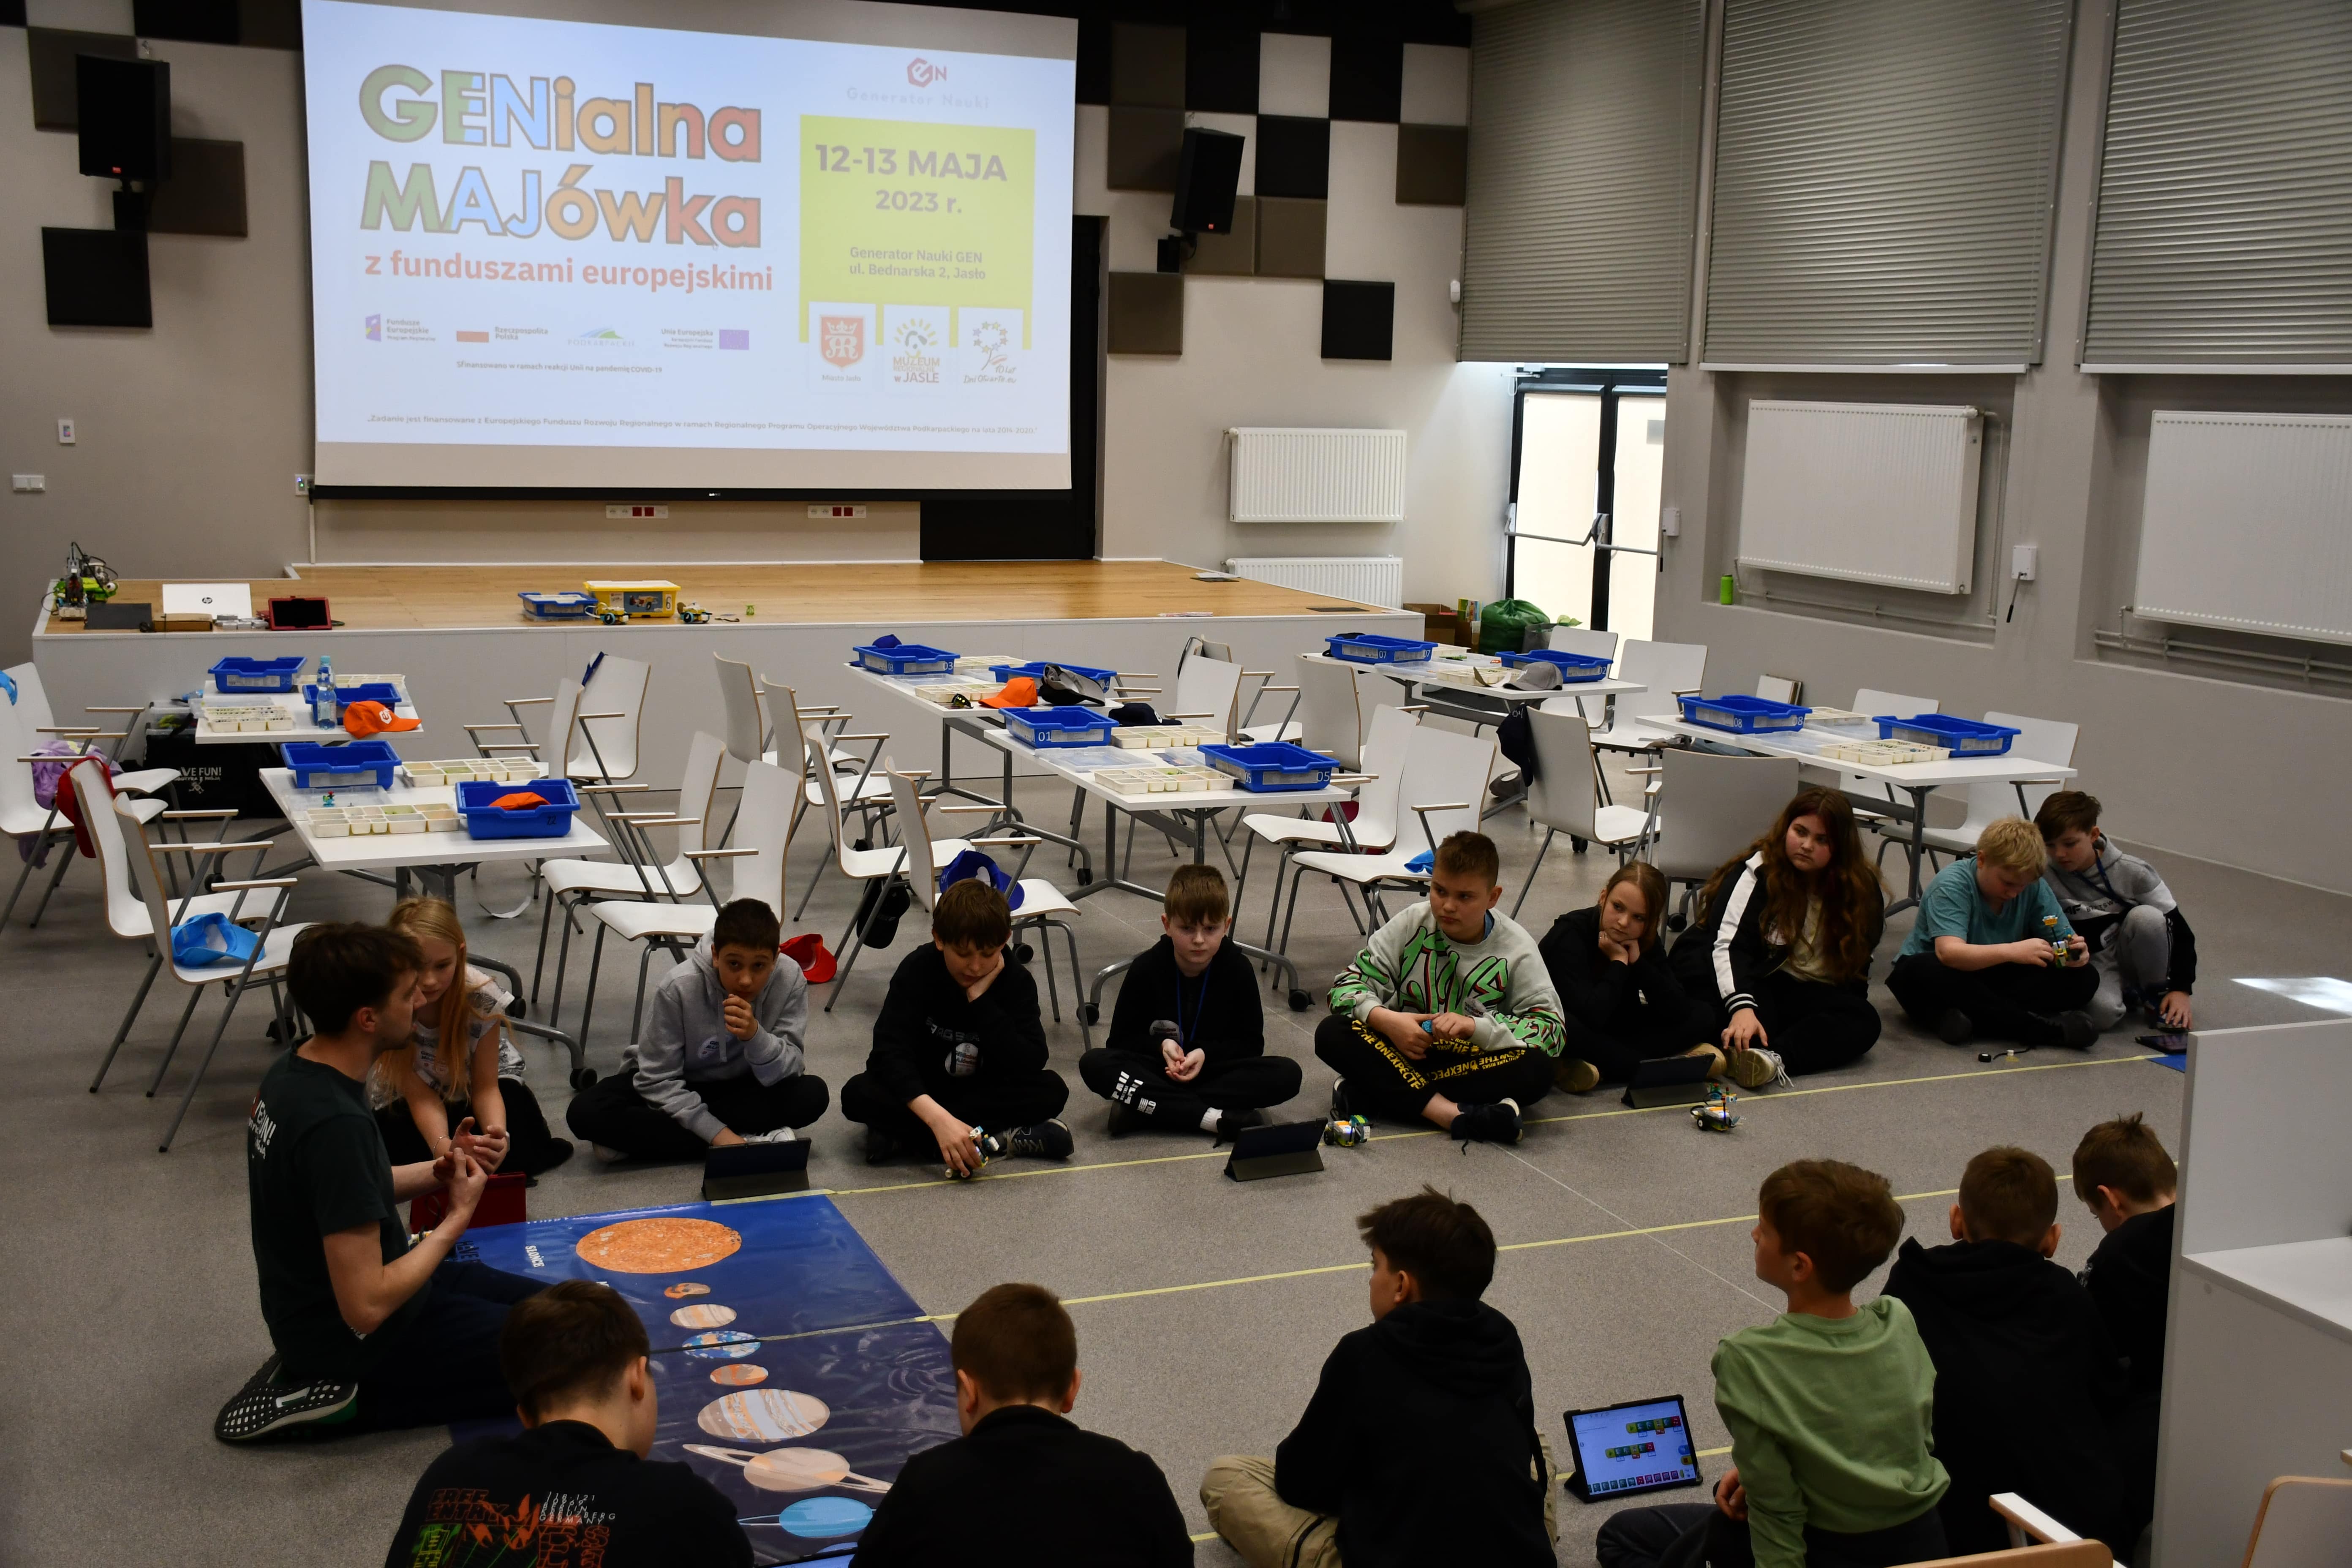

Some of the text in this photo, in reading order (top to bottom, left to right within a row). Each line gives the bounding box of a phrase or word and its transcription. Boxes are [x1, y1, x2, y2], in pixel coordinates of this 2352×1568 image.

[847, 87, 989, 109] Generator Nauki
[359, 64, 761, 163] GENialna
[815, 144, 1007, 182] 12-13 MAJA
[360, 160, 761, 248] MAJówka
[875, 190, 962, 213] 2023 r.
[850, 247, 983, 263] Generator Nauki GEN
[365, 251, 773, 293] z funduszami europejskimi
[849, 264, 986, 280] ul. Bednarska 2, Jasło
[495, 327, 548, 335] Rzeczpospolita
[456, 360, 507, 369] Sfinansowano
[545, 364, 568, 372] reakcji
[893, 357, 940, 367] MUZEUM
[406, 415, 421, 423] jest
[485, 417, 541, 425] Europejskiego
[584, 419, 617, 427] Rozwoju
[620, 419, 672, 428] Regionalnego
[807, 423, 858, 431] Operacyjnego
[913, 425, 970, 433] Podkarpackiego
[1379, 651, 1387, 659] 07
[888, 663, 894, 672] 03
[944, 662, 953, 670] 03
[1734, 718, 1742, 728] 08
[1038, 731, 1051, 742] 01
[199, 767, 222, 776] FUN!
[1316, 771, 1330, 782] 05
[539, 1514, 605, 1525] GERMANY
